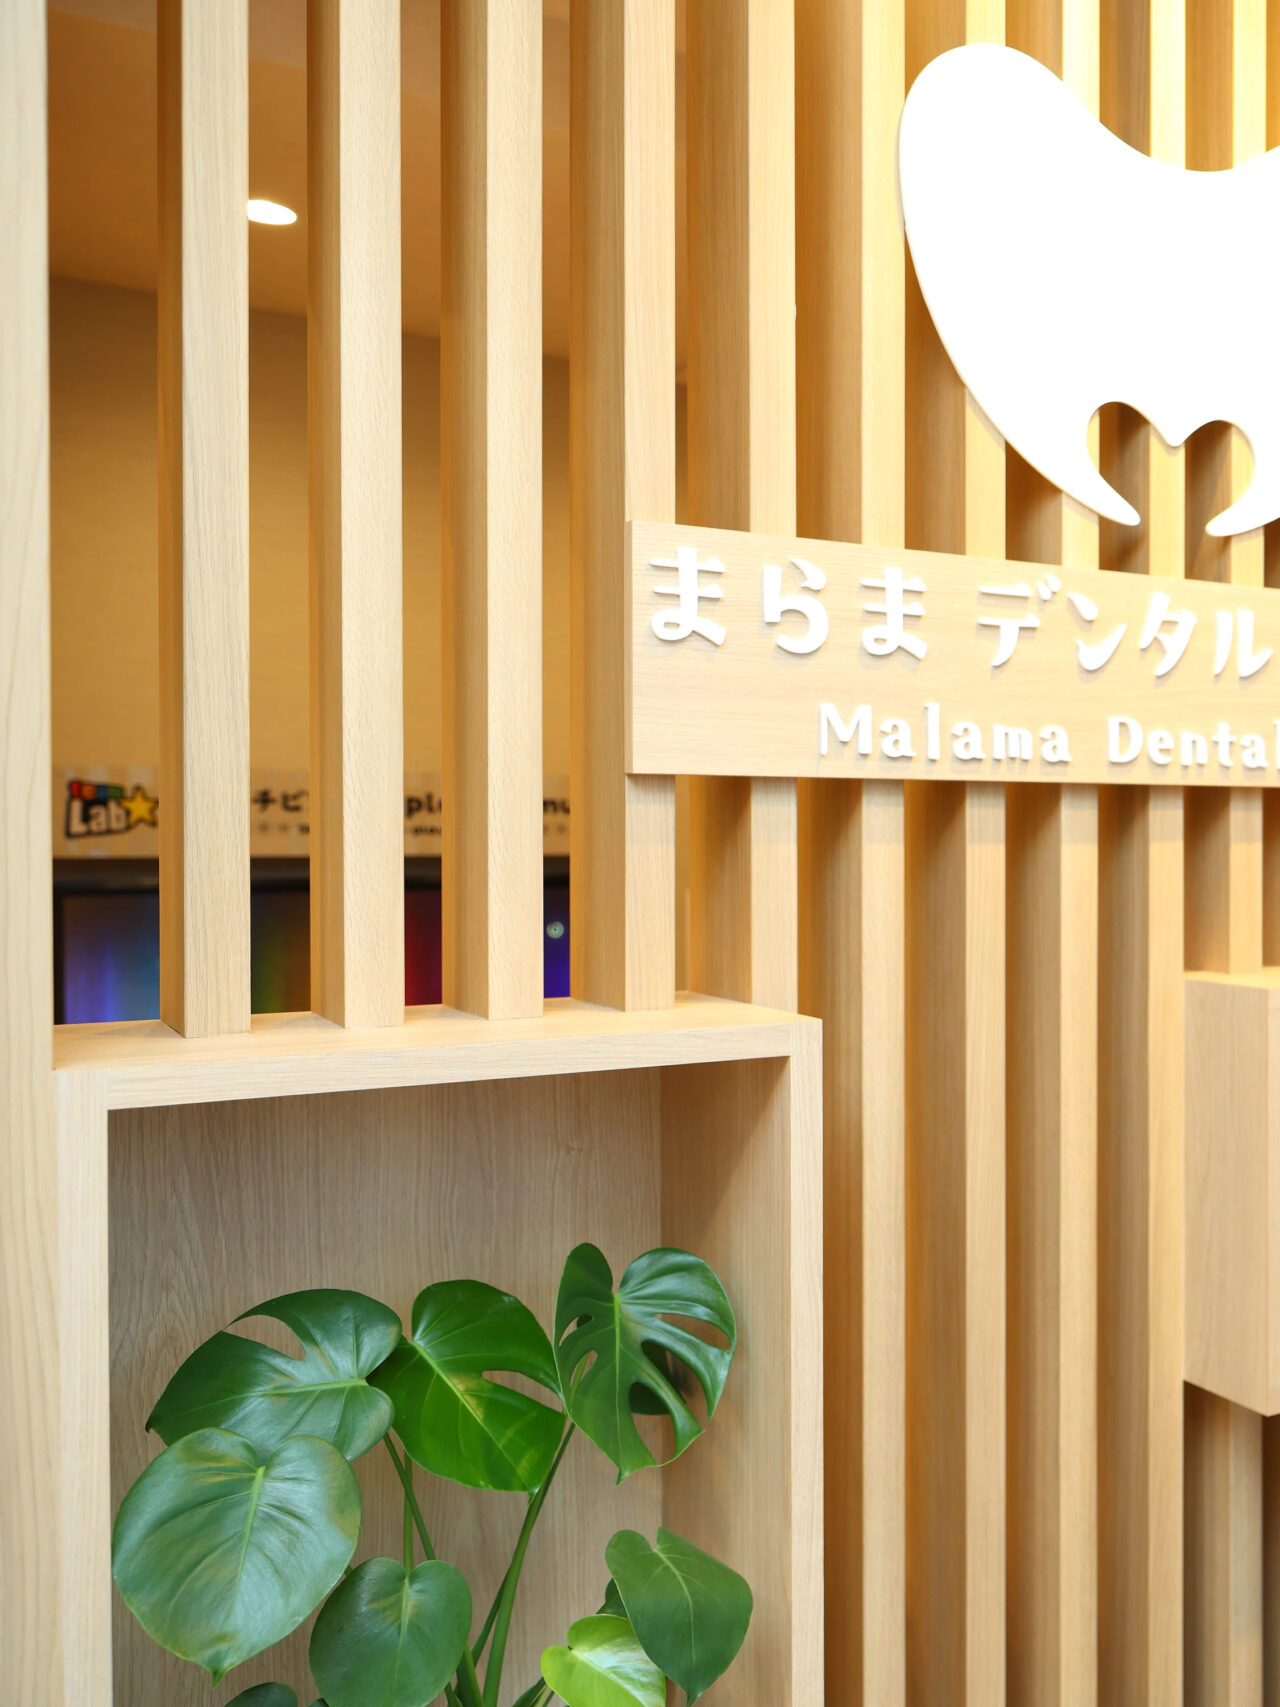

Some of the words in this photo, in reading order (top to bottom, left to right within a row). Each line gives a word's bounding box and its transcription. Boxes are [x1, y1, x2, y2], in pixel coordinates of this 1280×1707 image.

[649, 546, 928, 660] まらま
[819, 702, 1073, 763] Malama
